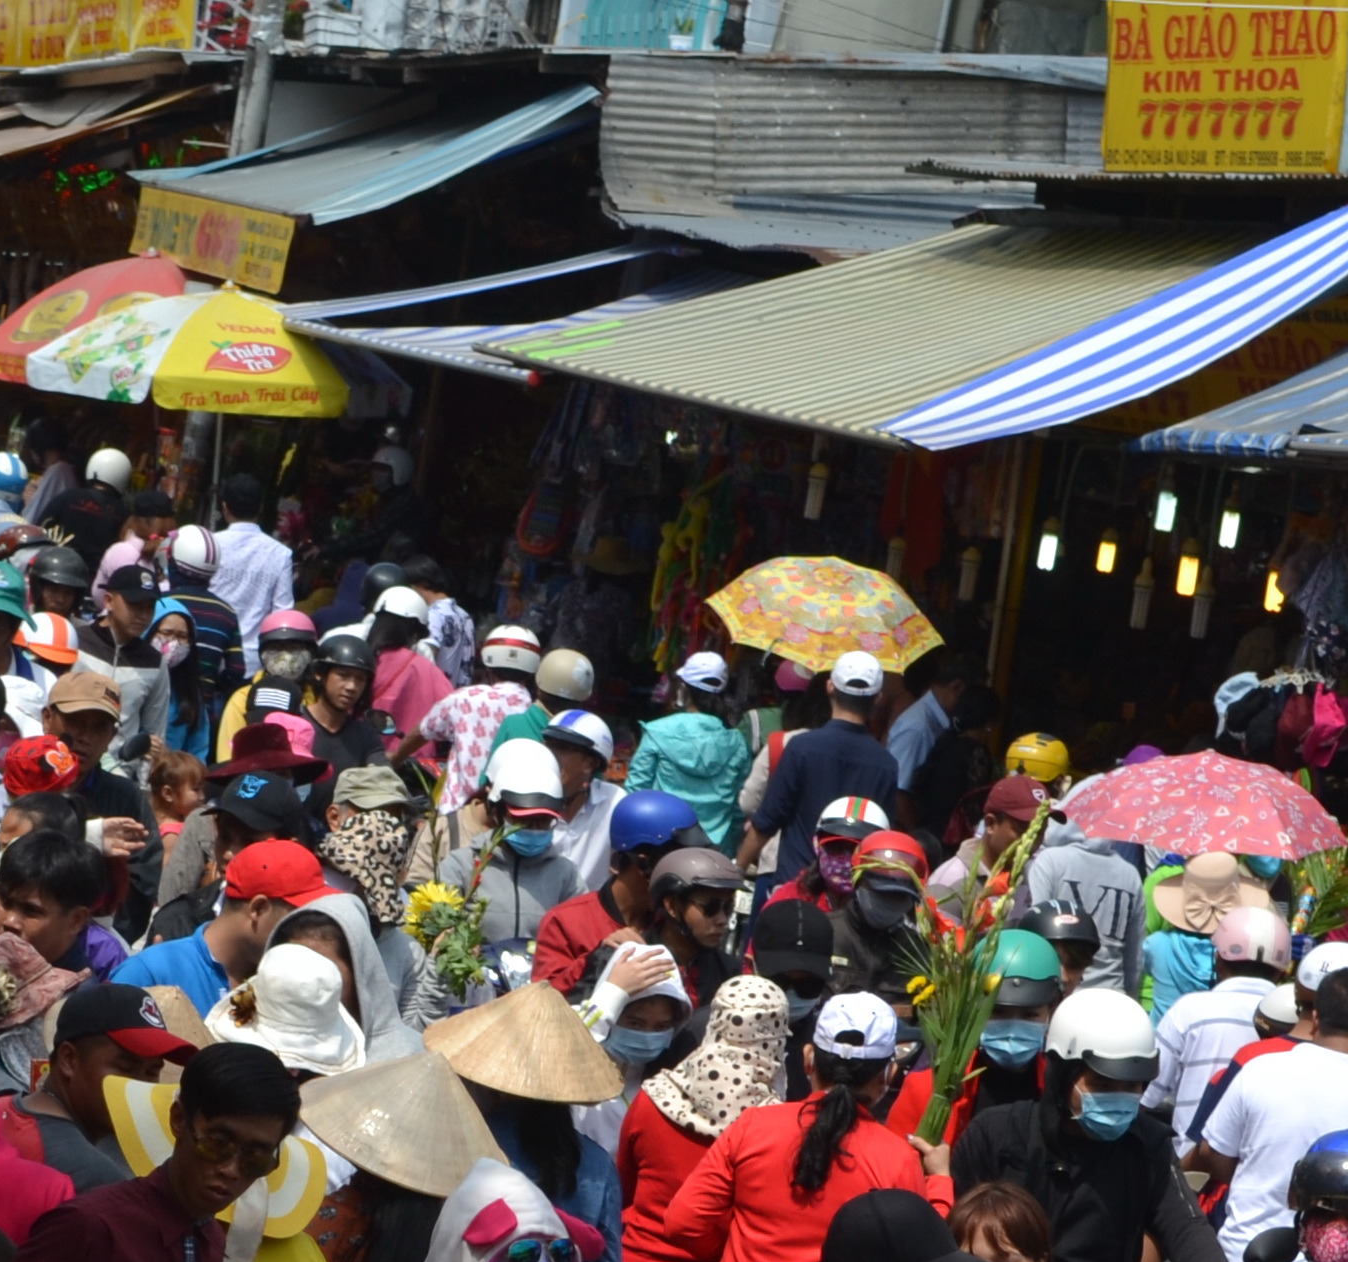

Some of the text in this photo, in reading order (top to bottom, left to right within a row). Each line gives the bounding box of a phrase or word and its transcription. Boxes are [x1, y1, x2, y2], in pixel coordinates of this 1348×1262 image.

[1113, 3, 1153, 62] BÀ
[1143, 67, 1300, 93] KIM THOA
[1138, 98, 1303, 140] 7777777
[216, 321, 277, 335] VEDAN
[221, 343, 277, 364] Thiên
[243, 357, 274, 373] Trà
[180, 391, 206, 409] Trà
[210, 389, 252, 407] Xanh
